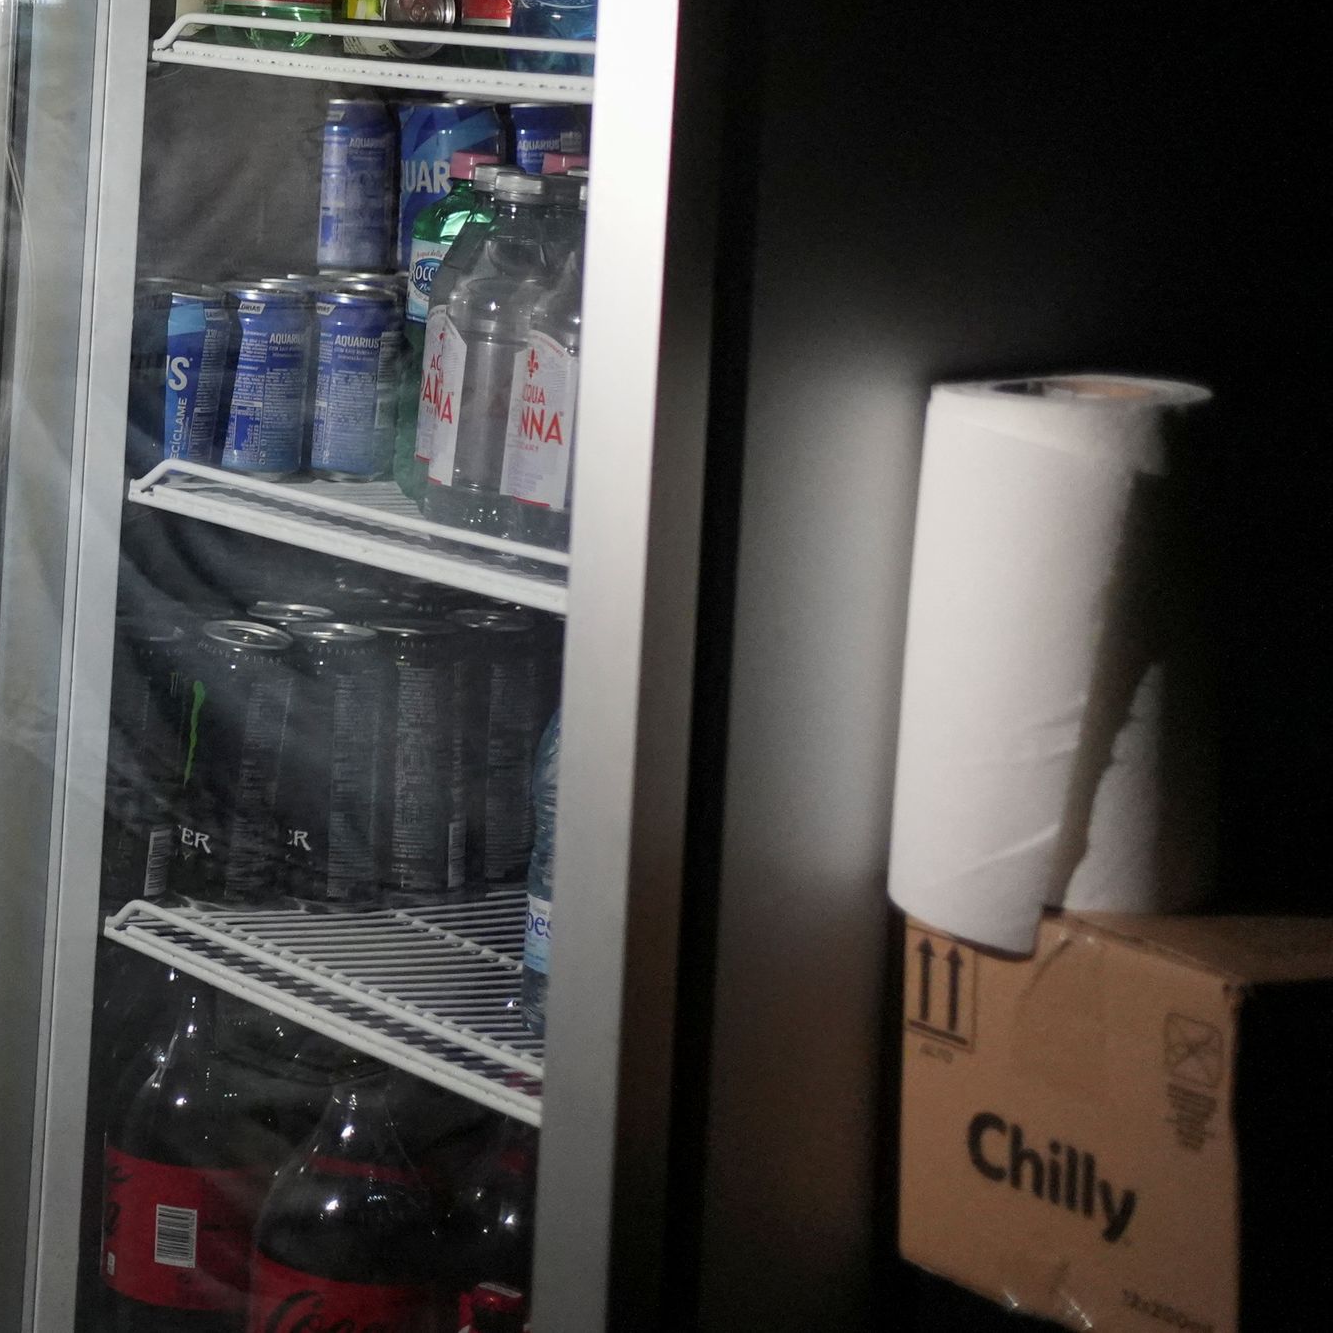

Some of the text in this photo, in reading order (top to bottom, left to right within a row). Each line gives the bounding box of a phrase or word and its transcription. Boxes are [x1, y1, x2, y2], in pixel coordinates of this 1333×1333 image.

[334, 334, 380, 349] AQUARIUS
[166, 355, 190, 392] S
[178, 824, 212, 855] ER
[966, 1111, 1137, 1243] Chilly
